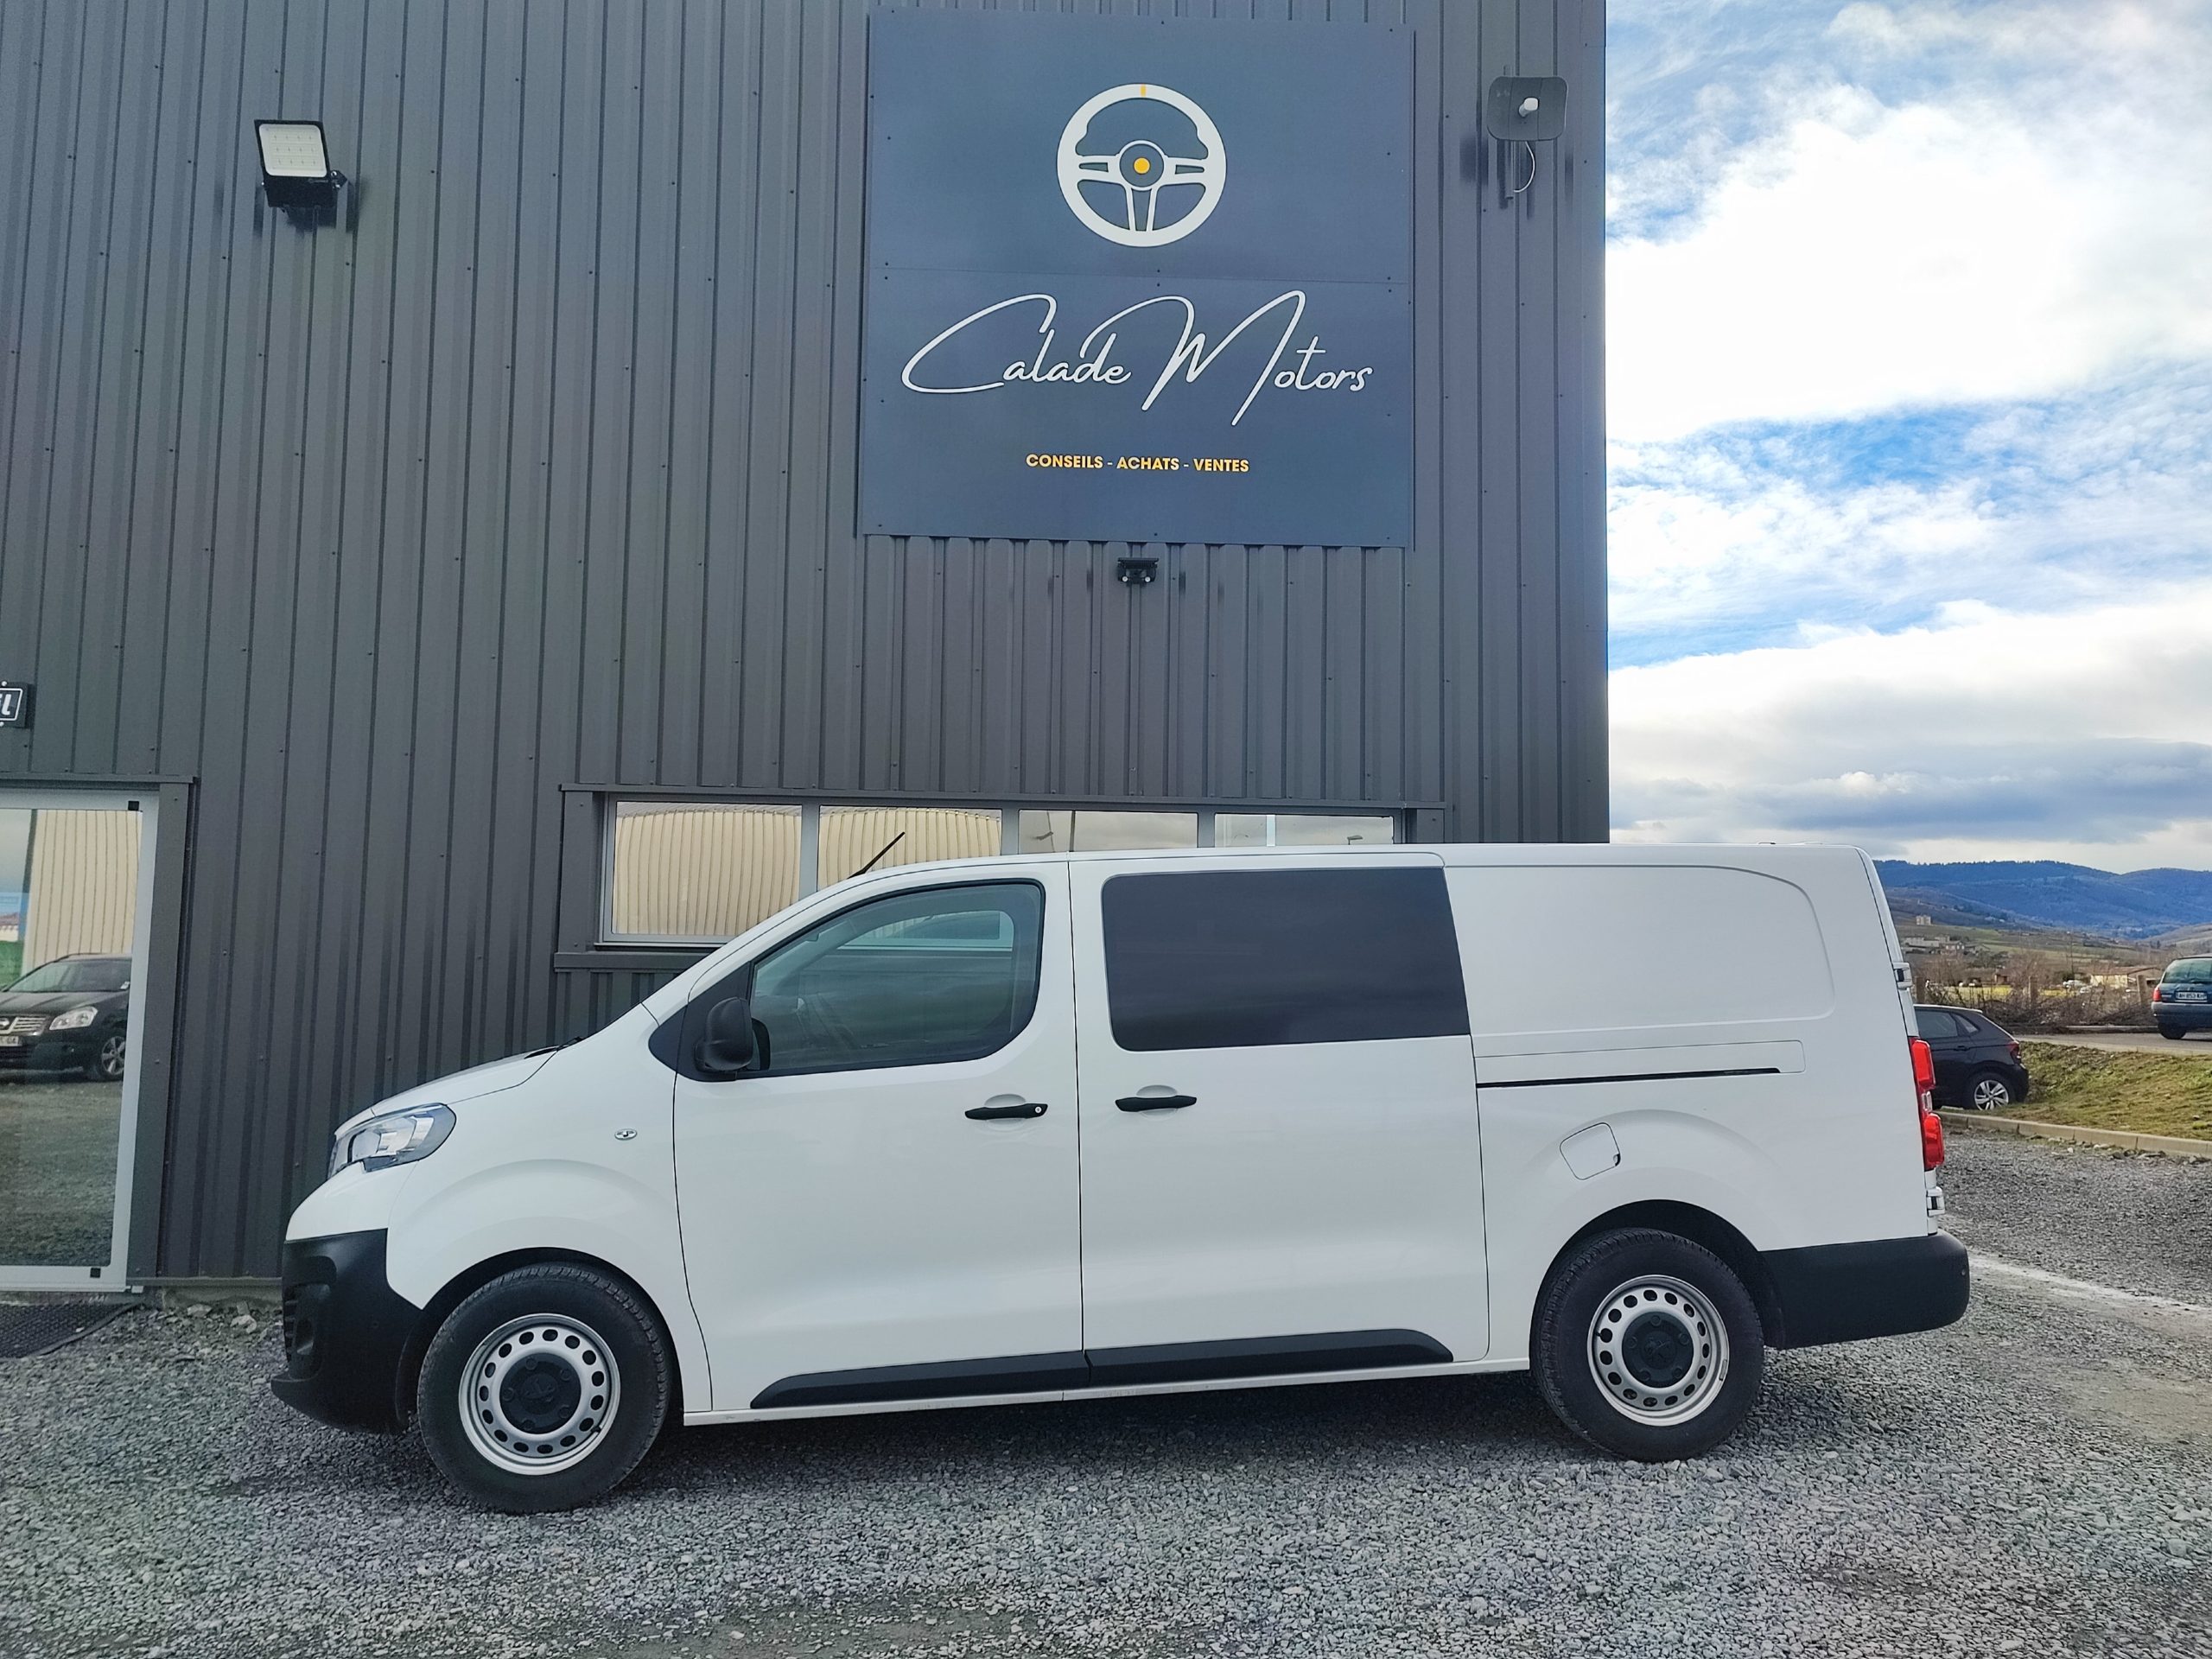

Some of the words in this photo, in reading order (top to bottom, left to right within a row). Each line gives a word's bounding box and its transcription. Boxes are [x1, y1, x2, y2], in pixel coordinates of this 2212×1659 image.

[901, 293, 1133, 394] Calade
[1079, 289, 1374, 426] Motors
[1026, 454, 1103, 469] CONSEILS
[1116, 456, 1179, 471] ACHATS
[1193, 458, 1249, 473] VENTES
